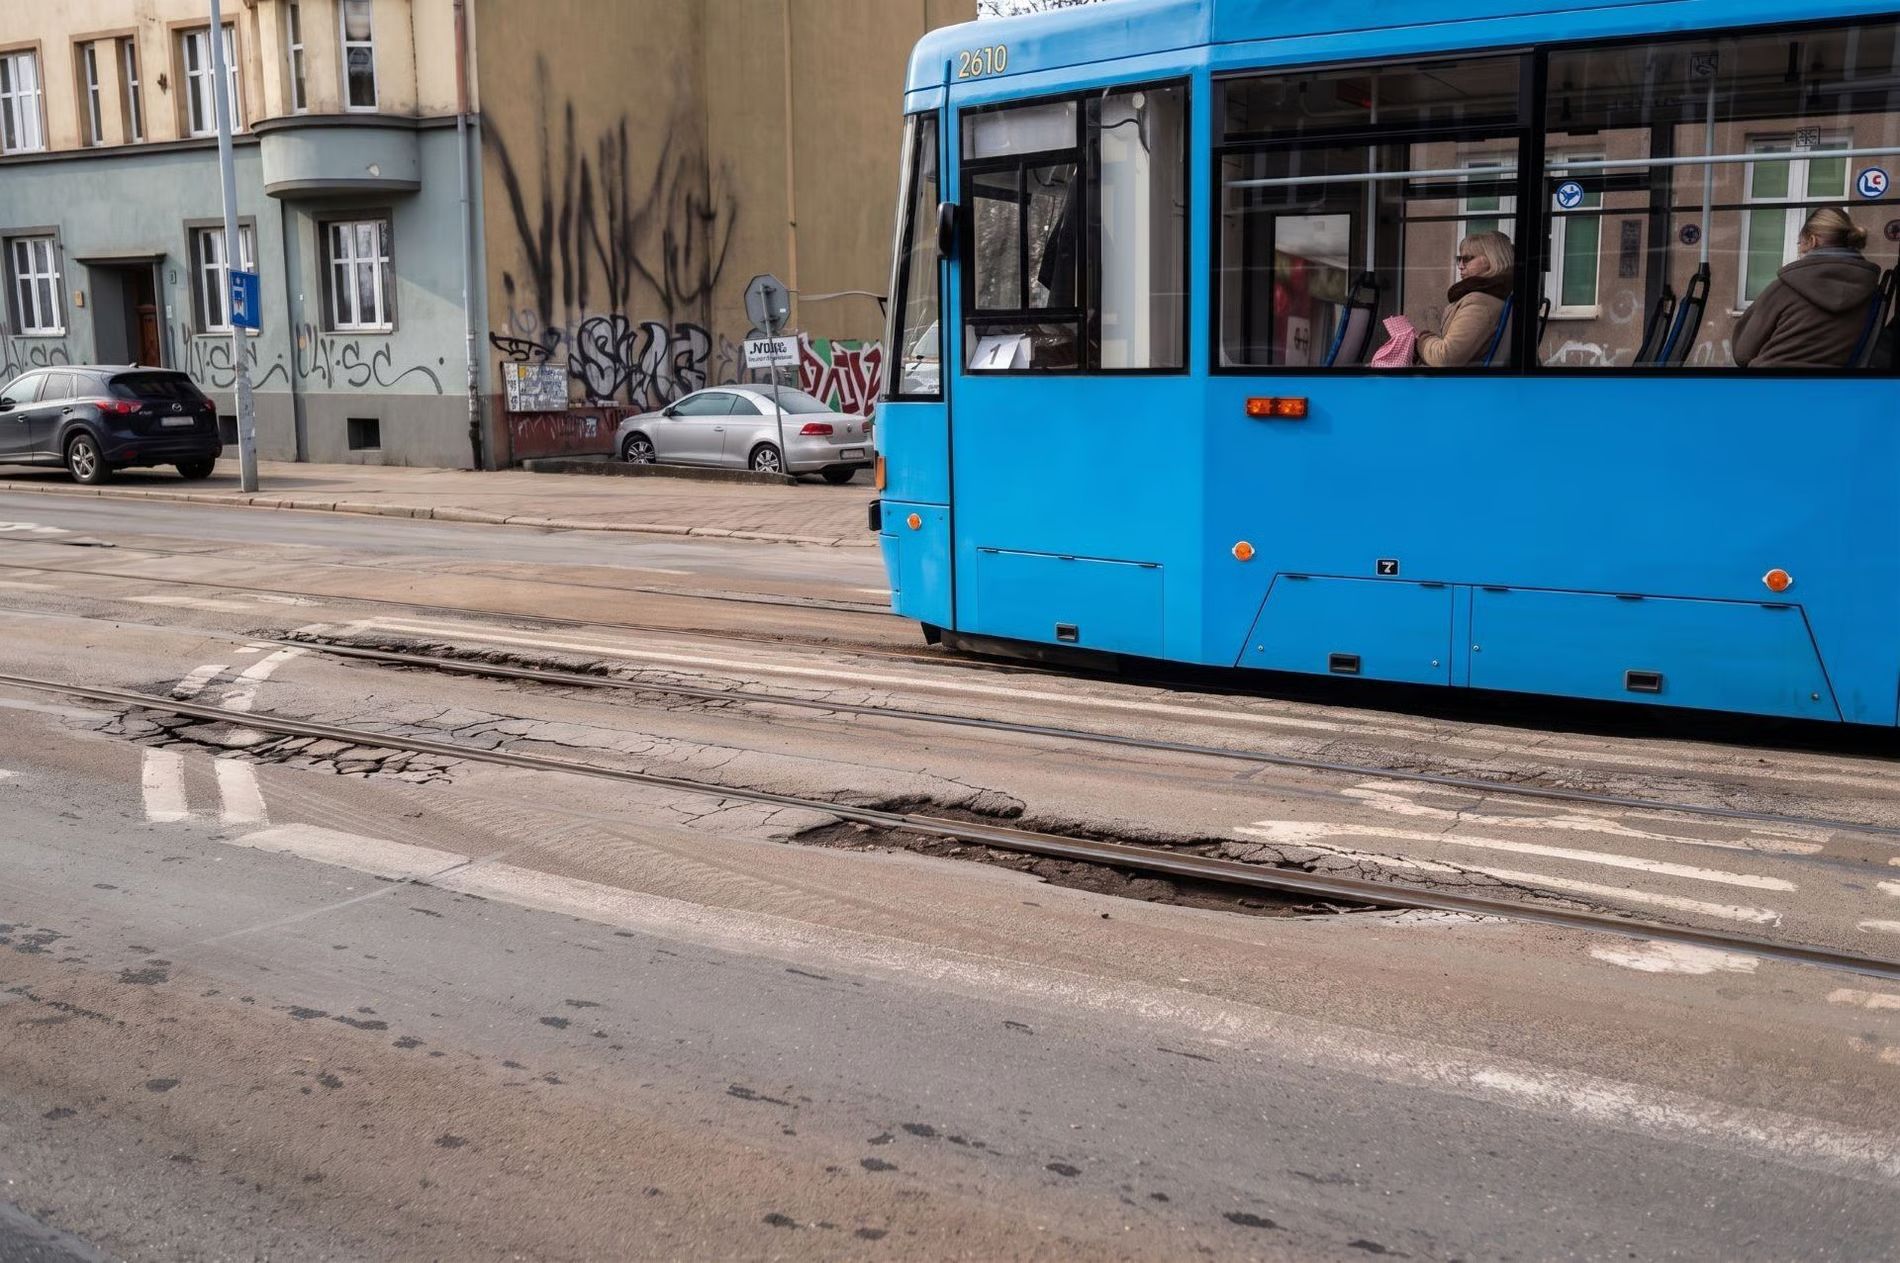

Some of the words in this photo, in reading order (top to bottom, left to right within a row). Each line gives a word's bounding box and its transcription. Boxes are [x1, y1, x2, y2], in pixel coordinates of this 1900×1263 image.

[959, 44, 1008, 78] 2610
[990, 343, 1001, 365] 1
[1381, 561, 1395, 574] 7
